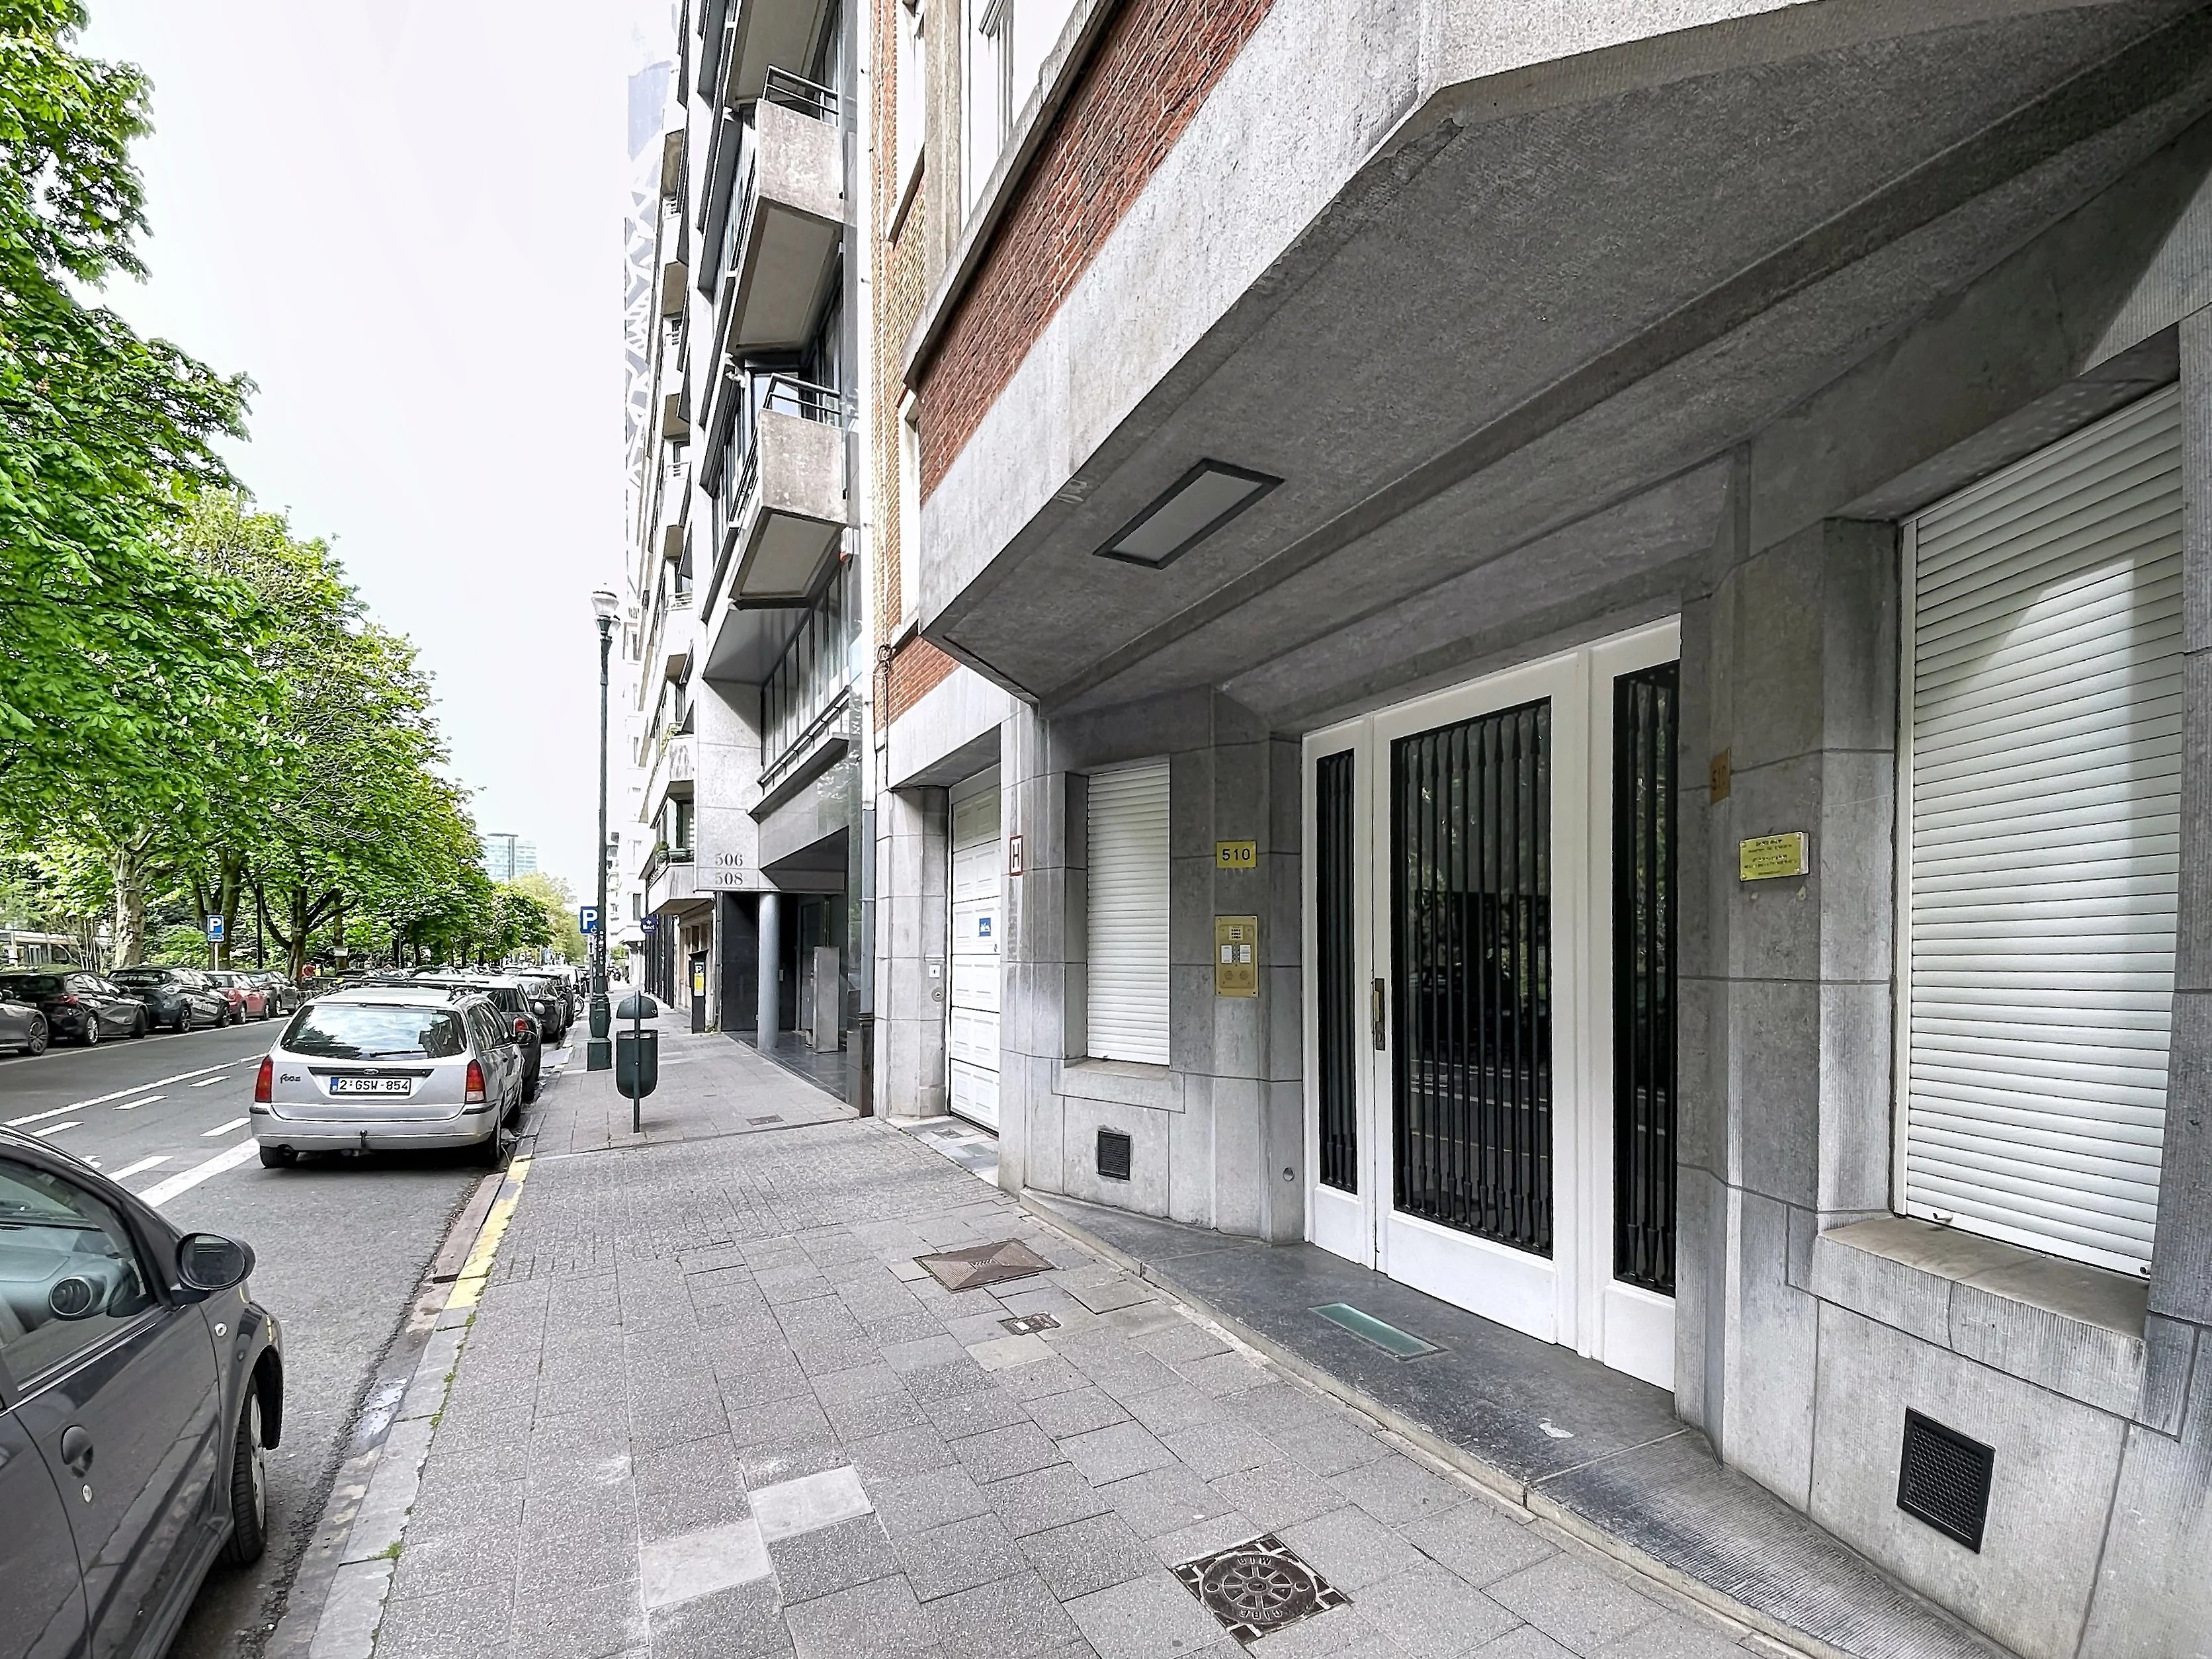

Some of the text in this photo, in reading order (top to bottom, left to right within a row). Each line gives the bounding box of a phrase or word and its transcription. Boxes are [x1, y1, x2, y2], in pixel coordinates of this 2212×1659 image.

[714, 852, 744, 867] 506
[1012, 843, 1020, 869] H
[1221, 847, 1251, 861] 510
[714, 872, 744, 886] 508
[209, 917, 222, 932] P
[582, 909, 598, 930] P
